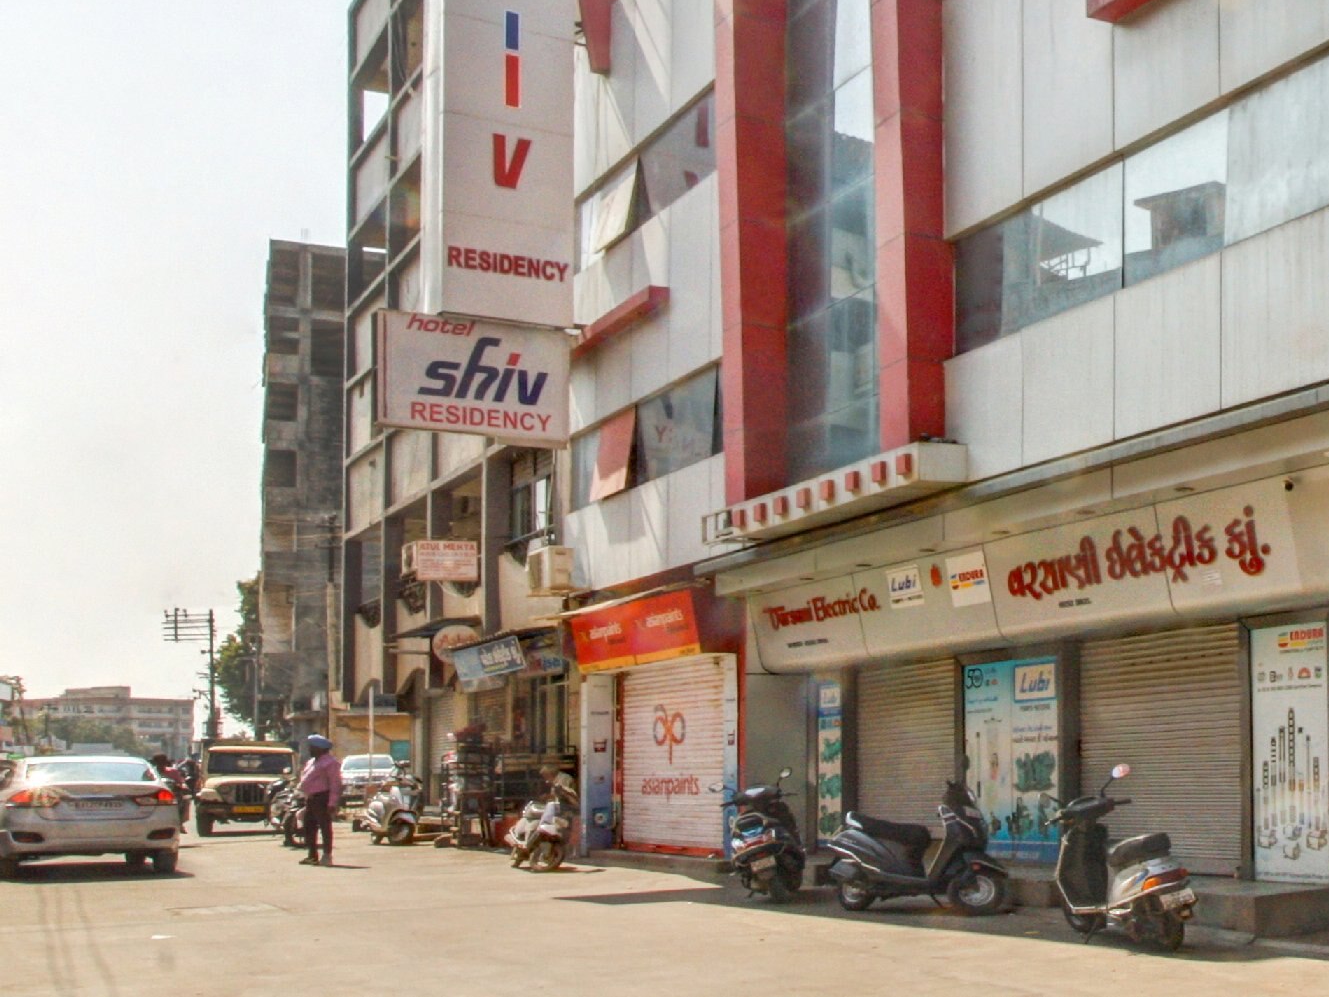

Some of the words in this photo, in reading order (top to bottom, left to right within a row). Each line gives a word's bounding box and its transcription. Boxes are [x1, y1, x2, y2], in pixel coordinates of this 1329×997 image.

[447, 246, 569, 283] RESIDENCY
[406, 313, 476, 337] hotel
[417, 336, 549, 405] shiv
[410, 401, 552, 433] RESIDENCY
[890, 573, 918, 593] Lubi
[1018, 670, 1051, 694] Lubi
[641, 774, 701, 803] asianpaints
